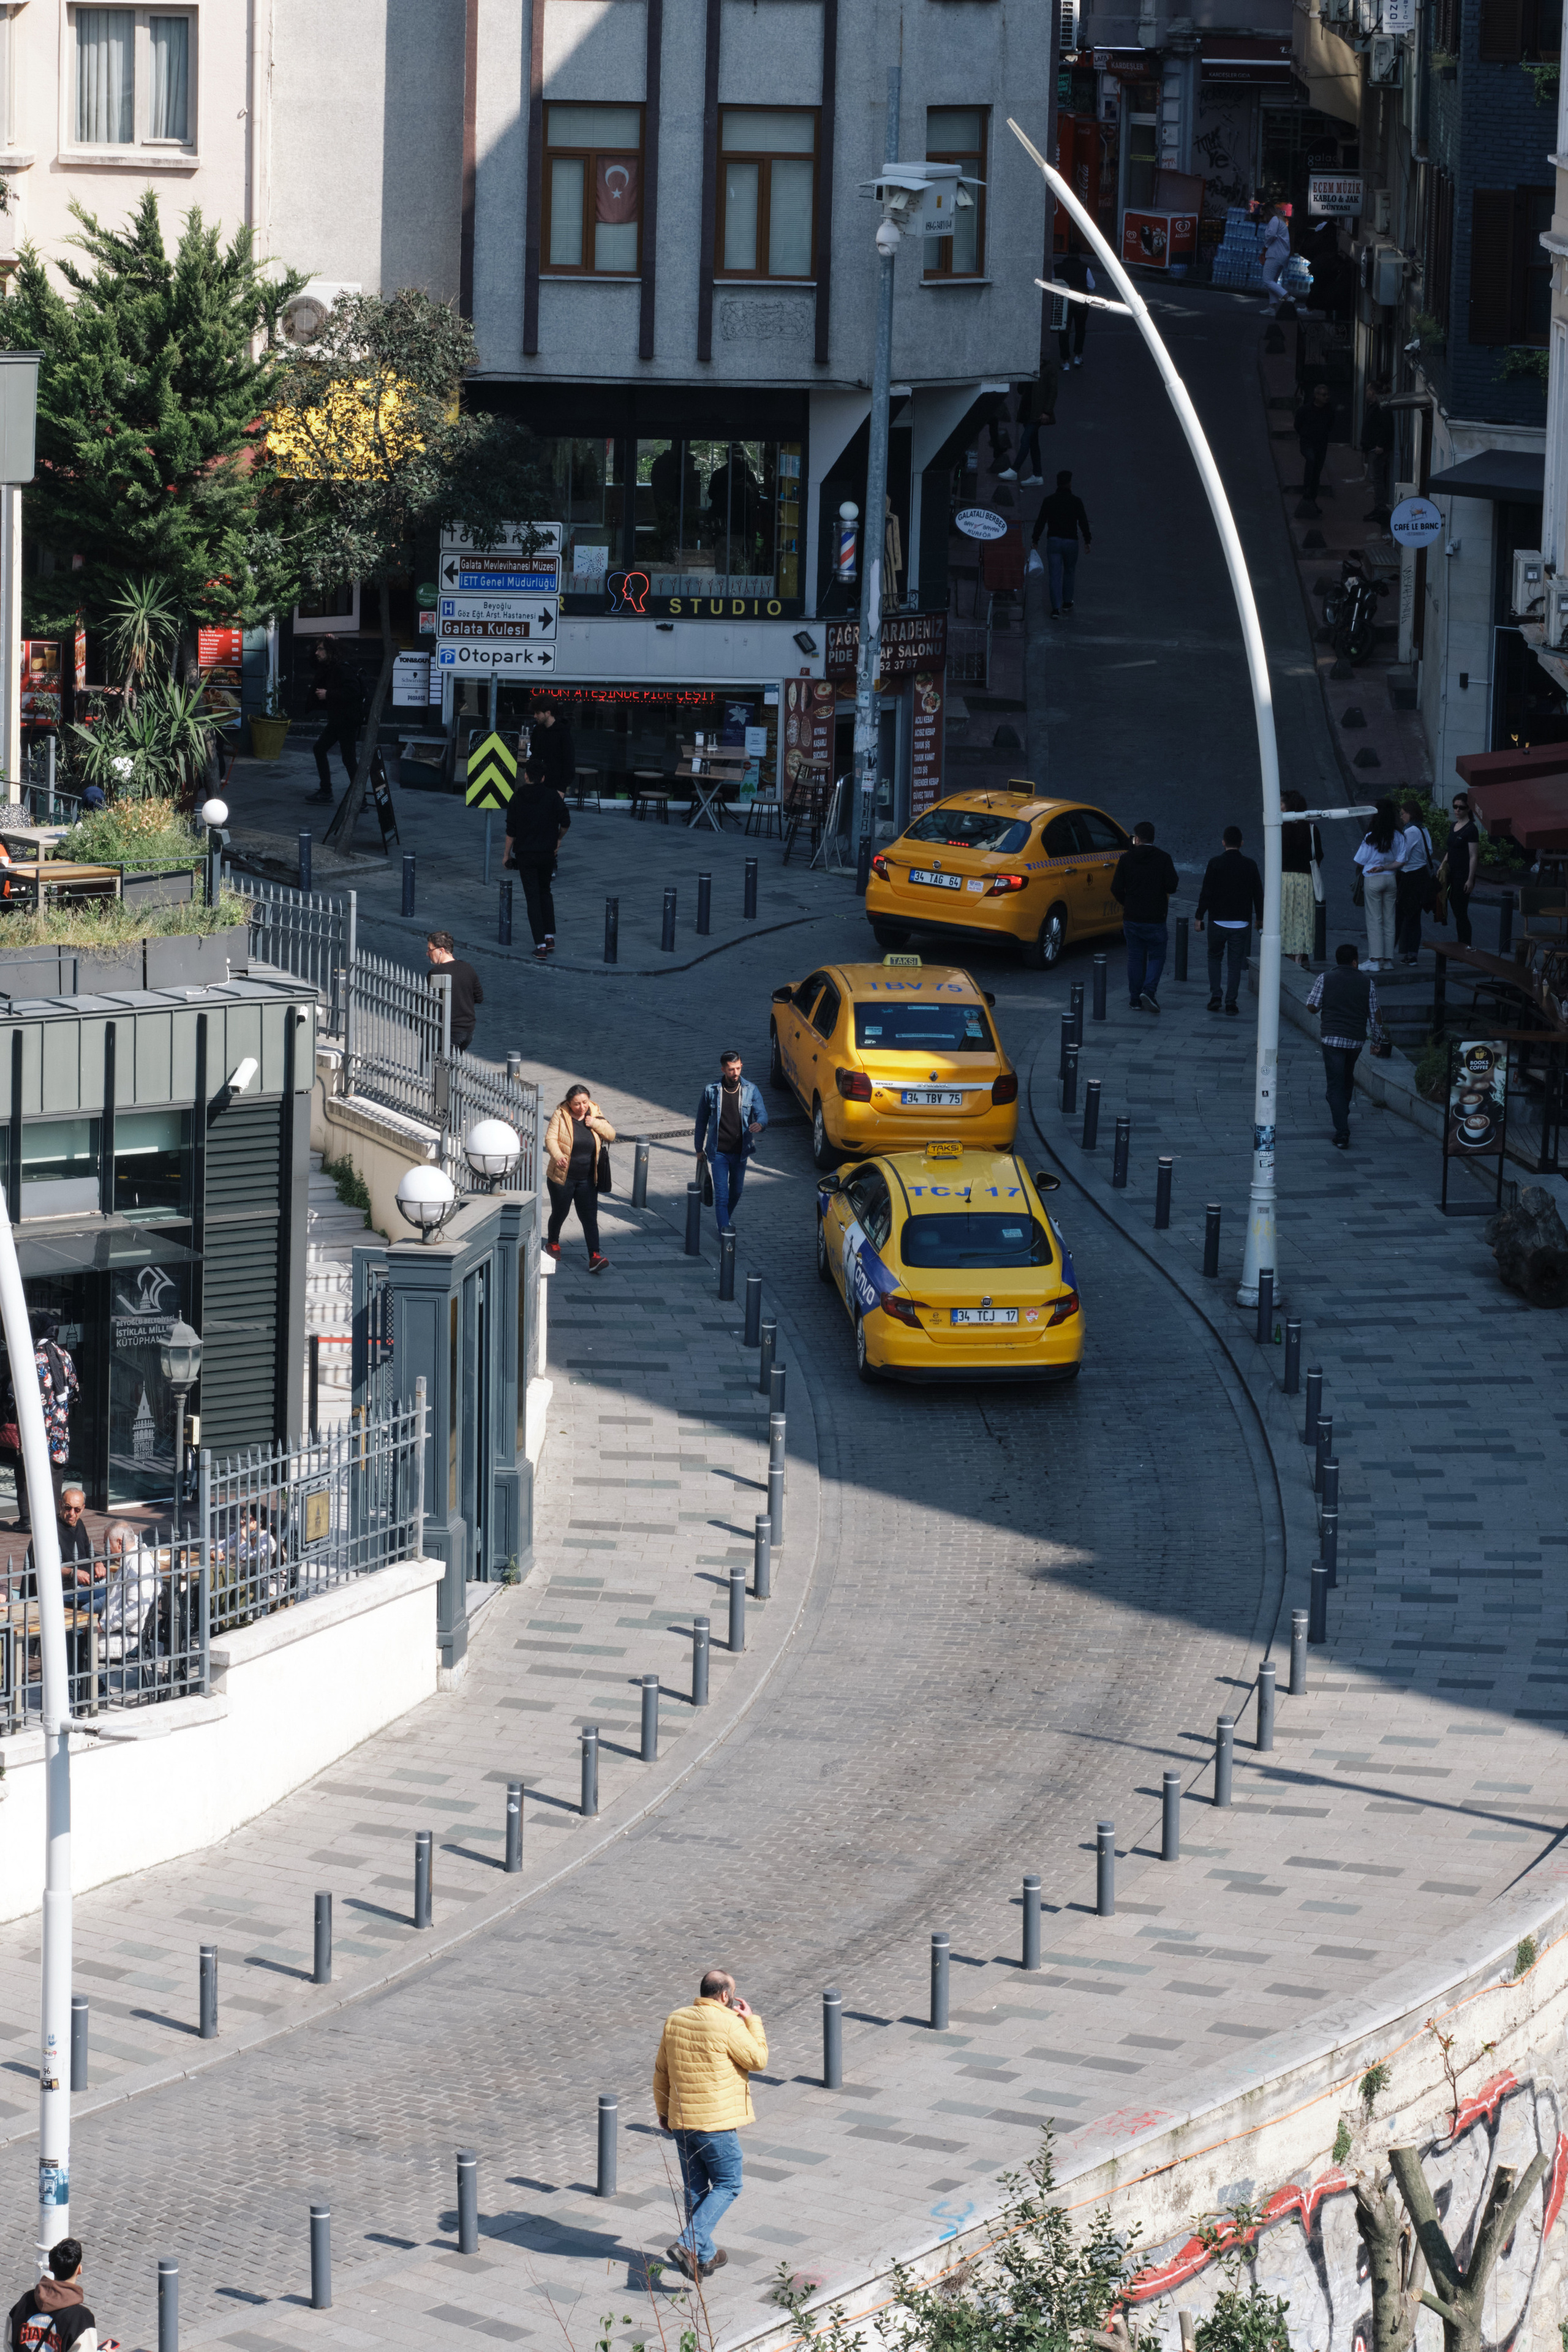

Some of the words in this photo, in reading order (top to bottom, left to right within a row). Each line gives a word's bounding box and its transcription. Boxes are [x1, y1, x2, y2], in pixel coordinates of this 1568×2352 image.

[1111, 61, 1144, 71] KARDEŞLER
[1313, 182, 1334, 193] ECEM
[1336, 180, 1361, 194] MÜZİK
[958, 510, 985, 521] GALATALİ
[985, 512, 1006, 531] BERBER
[461, 559, 482, 570] Galata
[483, 560, 530, 571] Mevlevihanesi
[532, 560, 556, 571] Müzesi
[460, 573, 478, 586] İETT
[481, 576, 505, 586] Genel
[507, 576, 555, 590] Müdürlüğü
[483, 601, 511, 610] Beyoğlu
[669, 598, 782, 616] STUDIO
[472, 611, 484, 619] Eğt.
[444, 621, 483, 634] Galata
[488, 622, 525, 636] Kulesi
[881, 616, 944, 643] ARADENİZ
[459, 647, 534, 667] Otopark
[828, 647, 853, 663] PİDE
[898, 642, 942, 658] SALONU
[894, 660, 905, 670] 37
[907, 659, 918, 669] 97
[923, 715, 934, 723] KEBAP
[813, 726, 827, 735] KIYMALI
[813, 739, 827, 749] KAŞARLI
[914, 741, 924, 749] TAVUK
[813, 750, 828, 759] SUCUKLU
[913, 766, 922, 775] KUZU
[913, 777, 929, 787] İSKENDER
[929, 777, 940, 786] KEBAP
[913, 791, 924, 801] GÜVEÇ
[924, 790, 934, 799] TAVUK
[913, 803, 924, 812] GÜVEÇ
[915, 872, 924, 881] 34
[930, 873, 944, 884] TAG
[949, 877, 959, 886] 64
[865, 982, 922, 990] TBV
[930, 982, 963, 992] 75
[907, 1093, 918, 1103] 34
[925, 1093, 942, 1104] TBV
[949, 1094, 960, 1104] 75
[908, 1186, 971, 1197] TCJ
[985, 1186, 1020, 1197] 17
[116, 1317, 143, 1327] BEYOĞLU
[144, 1314, 175, 1325] BELEDİYESİ
[959, 1311, 970, 1321] 34
[977, 1311, 995, 1321] TCJ
[1006, 1311, 1016, 1321] 17
[116, 1326, 147, 1337] İSTİKLAL
[134, 1441, 153, 1452] BEYOĞLU
[134, 1450, 153, 1461] BELEDİYESİ
